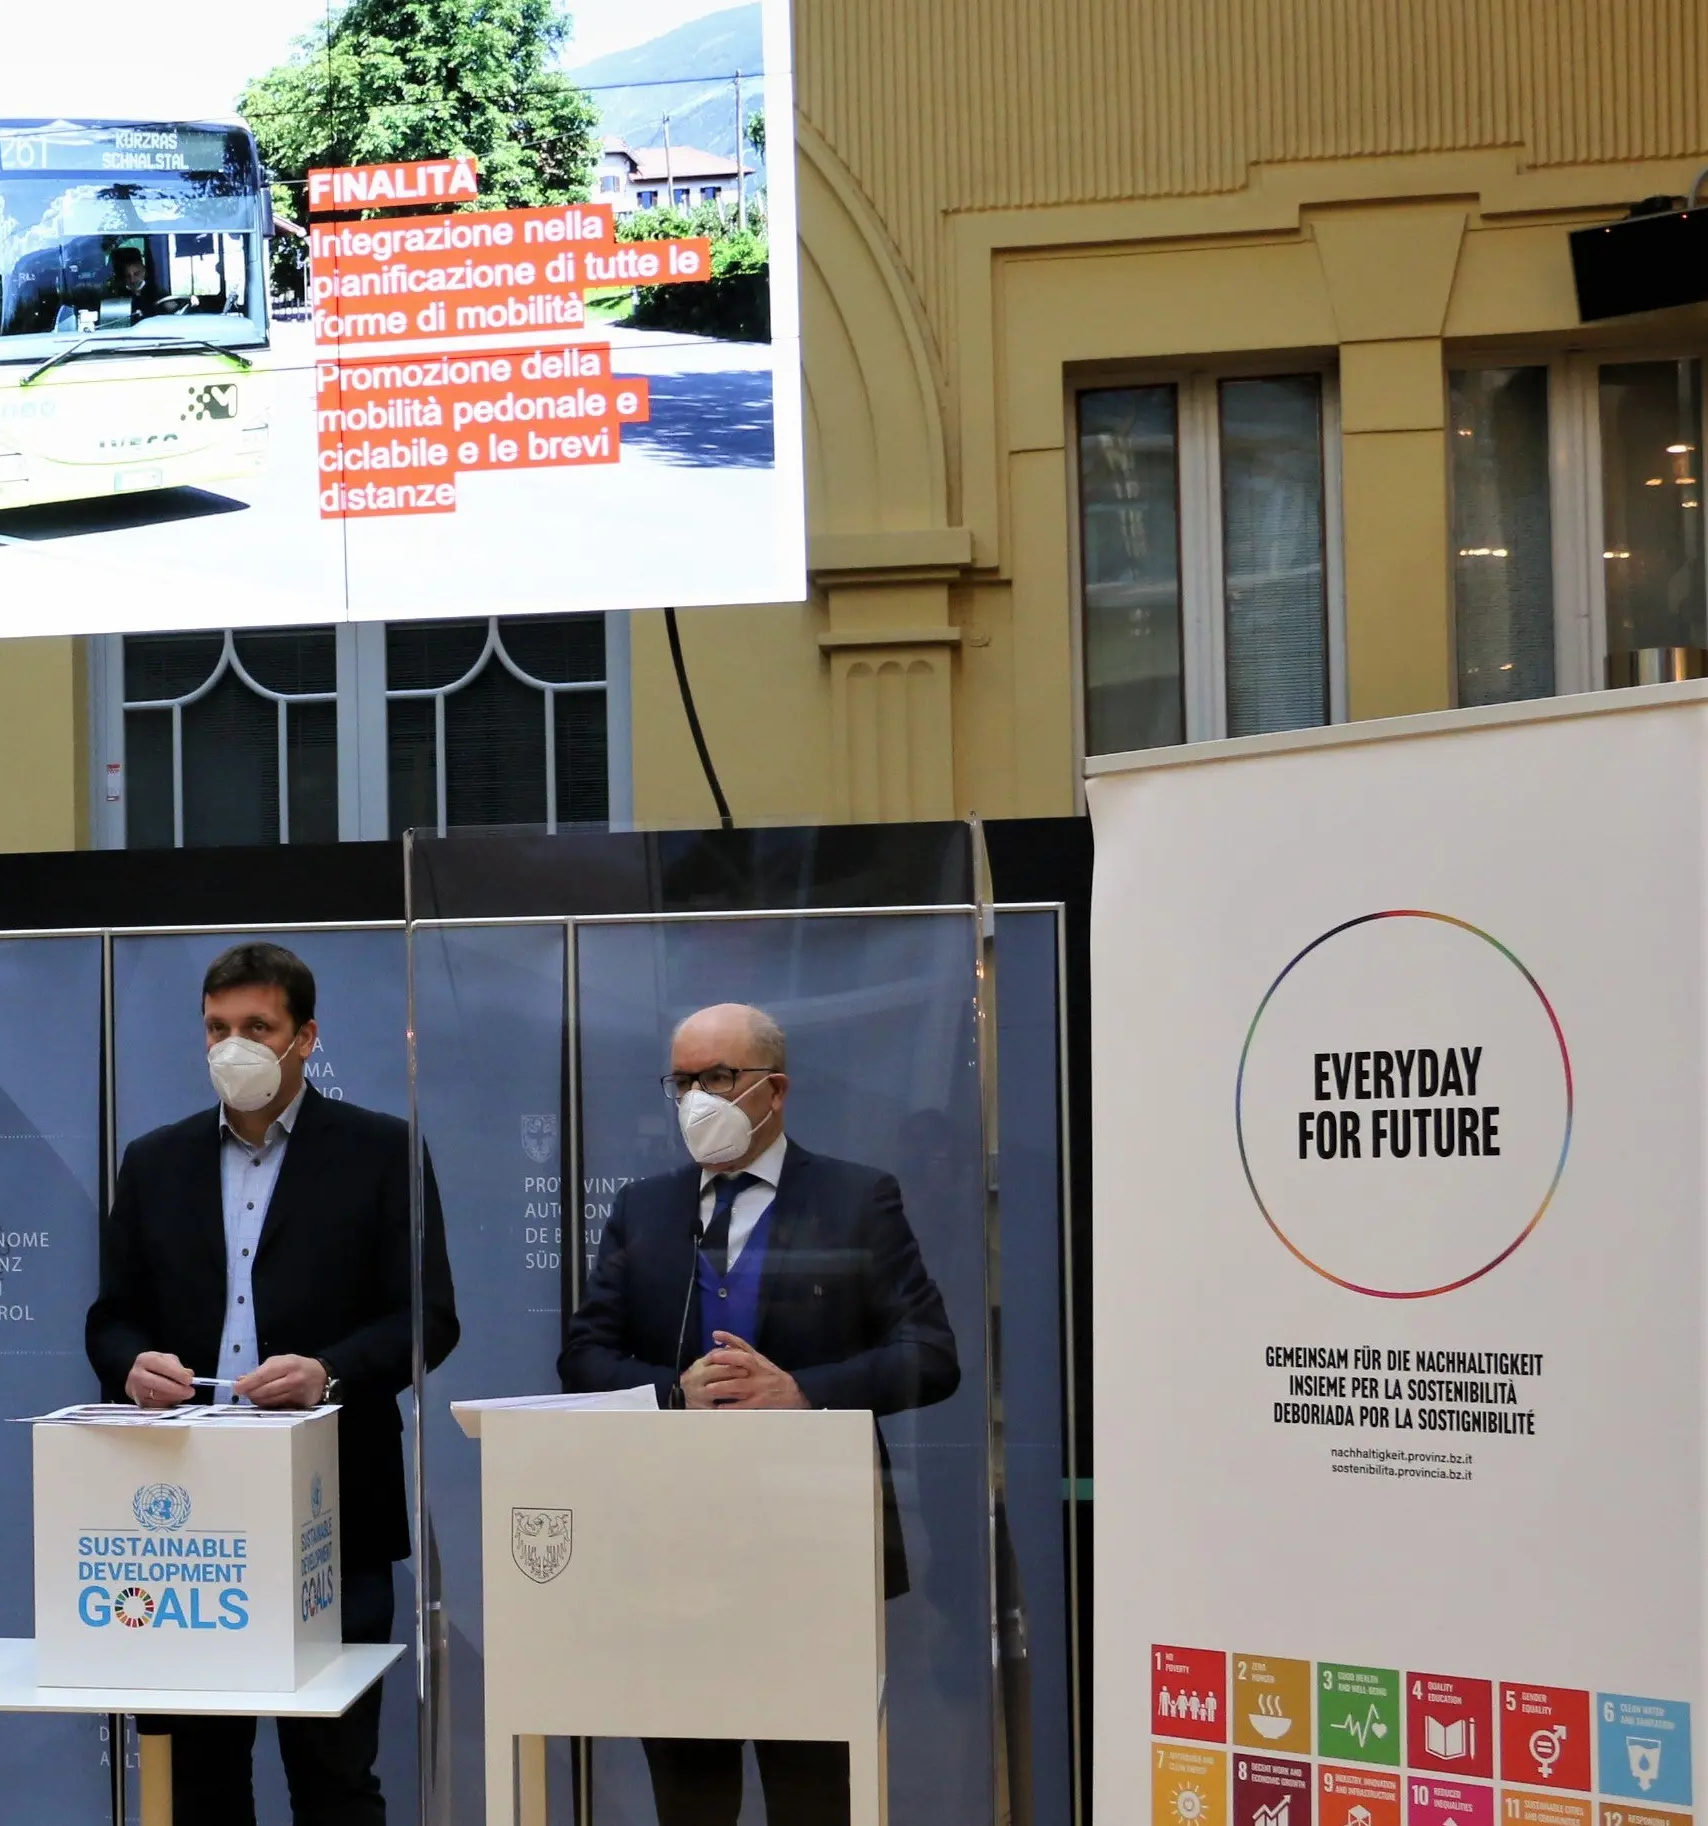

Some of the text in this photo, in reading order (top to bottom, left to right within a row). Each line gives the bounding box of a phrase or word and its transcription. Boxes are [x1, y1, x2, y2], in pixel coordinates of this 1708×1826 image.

[115, 132, 178, 150] KURZRAS
[101, 152, 189, 170] SCHNALSTAL
[309, 159, 478, 204] FINALITÀ
[312, 211, 604, 261] Integrazione nella
[313, 246, 700, 303] pianificazione di tutte le
[314, 296, 584, 338] forme di mobilità
[317, 350, 600, 393] Promozione della
[318, 389, 637, 433] mobilità pedonale e
[319, 428, 609, 472] ciclabile e le brevi
[319, 480, 456, 512] distanze
[1314, 1046, 1483, 1101] EVERYDAY
[1298, 1106, 1501, 1160] FOR FUTURE
[525, 1227, 549, 1244] DE
[1265, 1345, 1544, 1377] GEMEINSAM FÜR DIE NACHHALTIGKEIT
[1289, 1375, 1518, 1405] INSIEME PER LA SOSTENIBILITÀ
[1273, 1402, 1536, 1436] DEBORIADA POR LA SOSTIGNIBILITÉ
[1331, 1447, 1473, 1465] nachhaltigkeit.provinz.bz.it
[1331, 1464, 1473, 1481] sostenibilita.provincia.bz.it
[78, 1536, 248, 1559] SUSTAINABLE
[78, 1561, 248, 1583] DEVELOPMENT
[77, 1585, 250, 1631] GOALS
[1154, 1652, 1162, 1671] 1
[1165, 1664, 1190, 1674] POVERTY
[1237, 1661, 1248, 1681] 2
[1322, 1670, 1333, 1690] 3
[1412, 1680, 1454, 1700] 4 QUALITY
[1427, 1693, 1463, 1705] EDUCATION
[1505, 1691, 1517, 1711] 5
[1521, 1703, 1552, 1716] EQUALITY
[1603, 1702, 1615, 1722] 6
[1156, 1750, 1164, 1769] 7
[1238, 1761, 1302, 1781] 8 DECENT WORK AND
[1323, 1773, 1334, 1793] 9
[1411, 1785, 1461, 1806] 10 REDUCED
[1505, 1798, 1521, 1819] 11
[1603, 1811, 1623, 1826] 12
